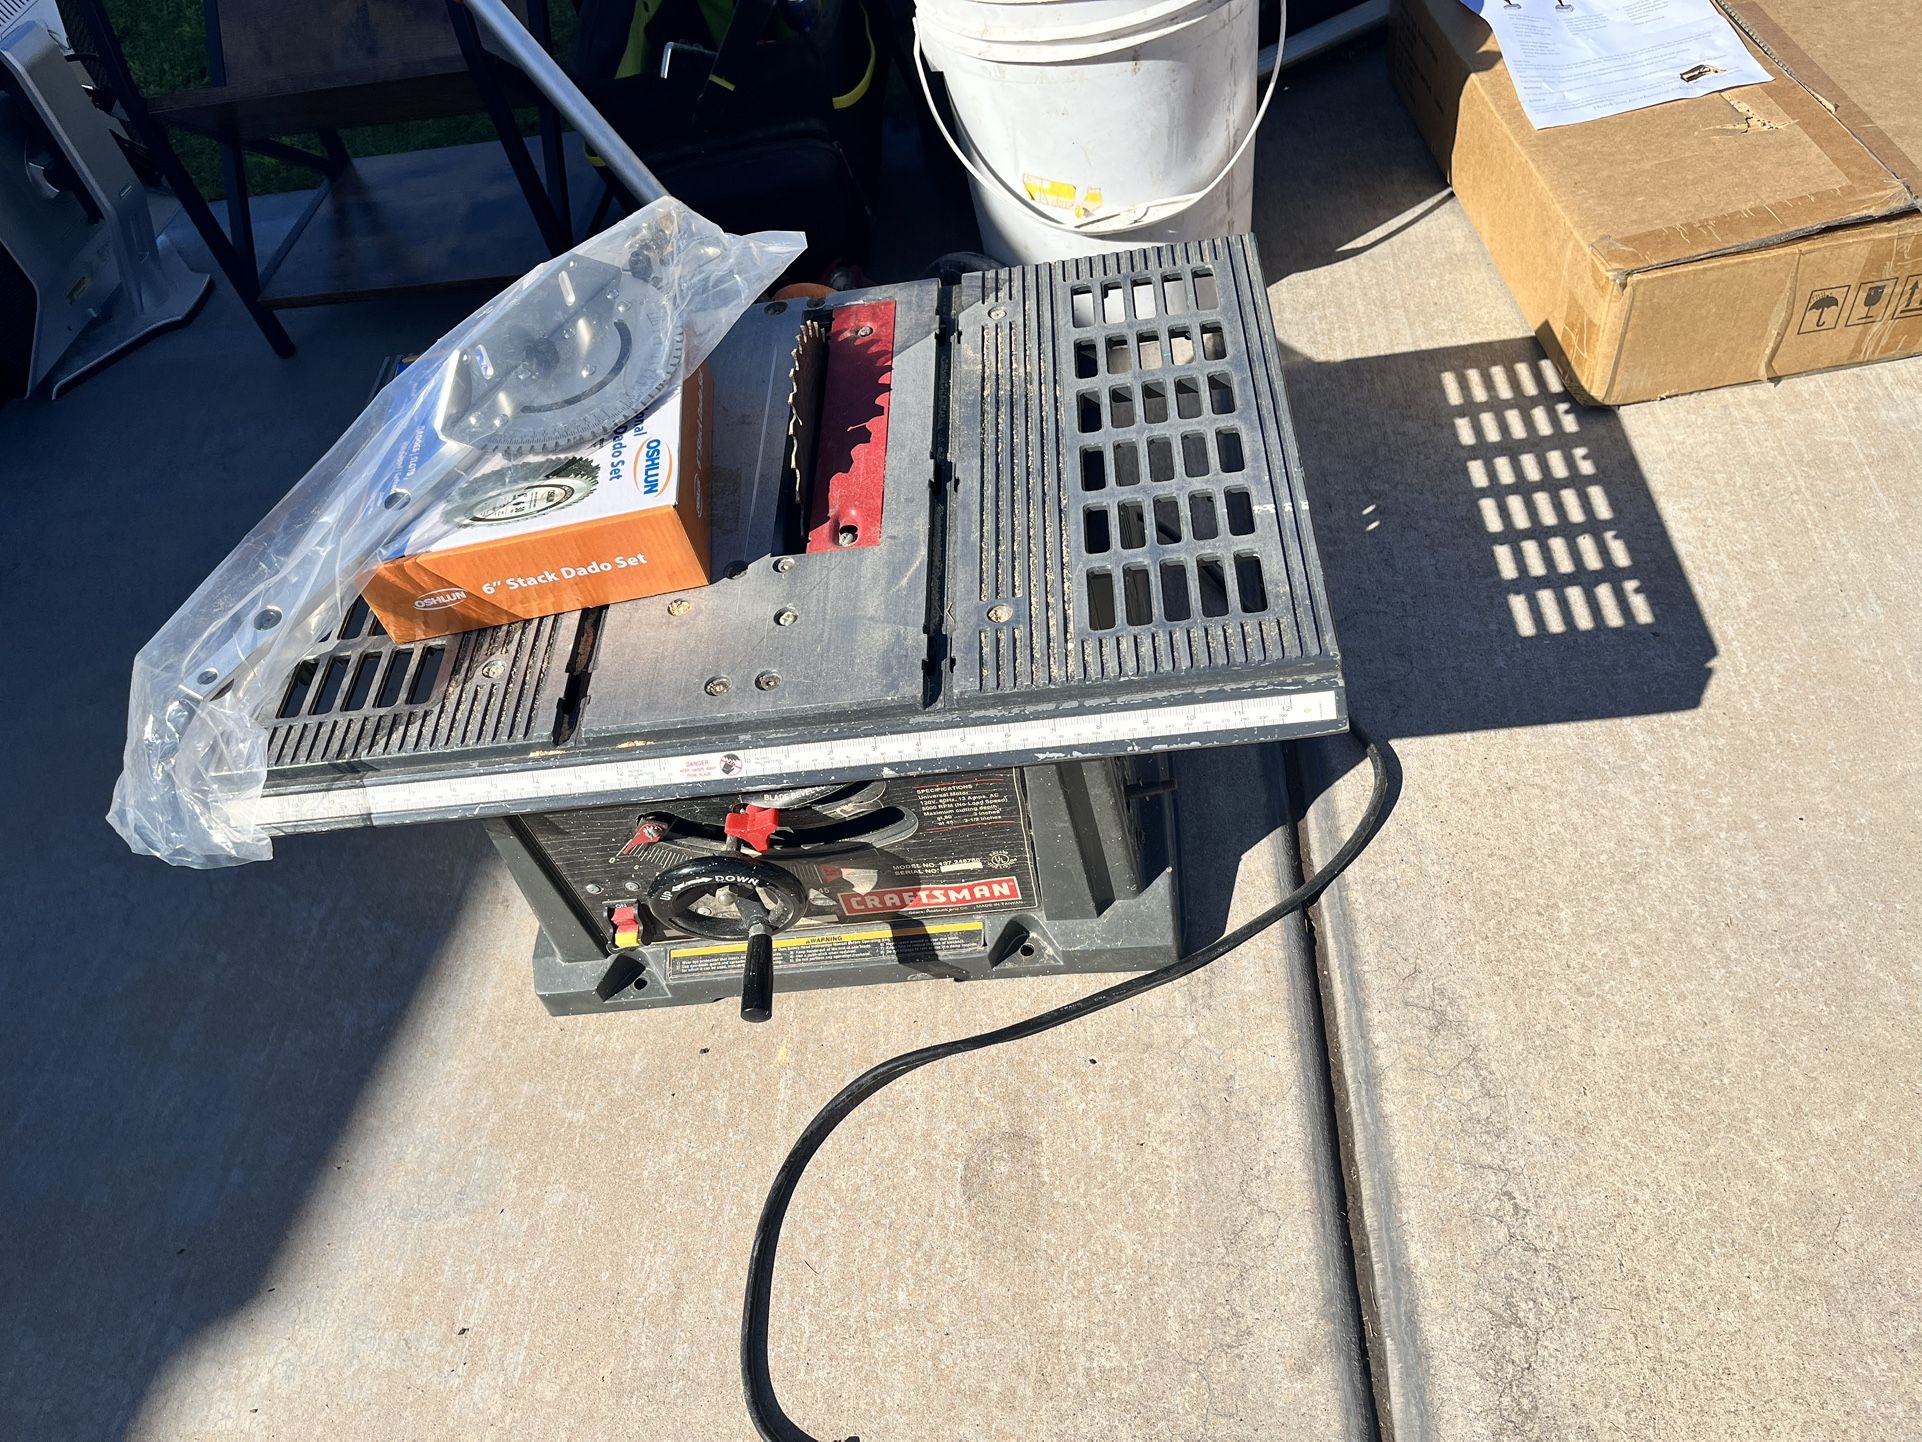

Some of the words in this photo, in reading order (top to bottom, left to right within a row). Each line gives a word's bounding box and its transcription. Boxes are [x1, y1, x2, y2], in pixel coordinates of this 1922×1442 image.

[612, 425, 628, 459] Dado
[609, 459, 625, 482] Set
[643, 438, 661, 495] OSHLUN
[414, 589, 467, 610] OSHLUN
[501, 571, 558, 591] Stack
[560, 561, 613, 582] Dado
[617, 552, 648, 569] Set
[763, 793, 789, 802] BLADE
[916, 784, 973, 794] SPECIFICATIONS
[714, 875, 759, 886] DOWN
[660, 891, 673, 901] UP
[851, 881, 1012, 911] CRAFTSMAN
[810, 935, 843, 944] WARNING
